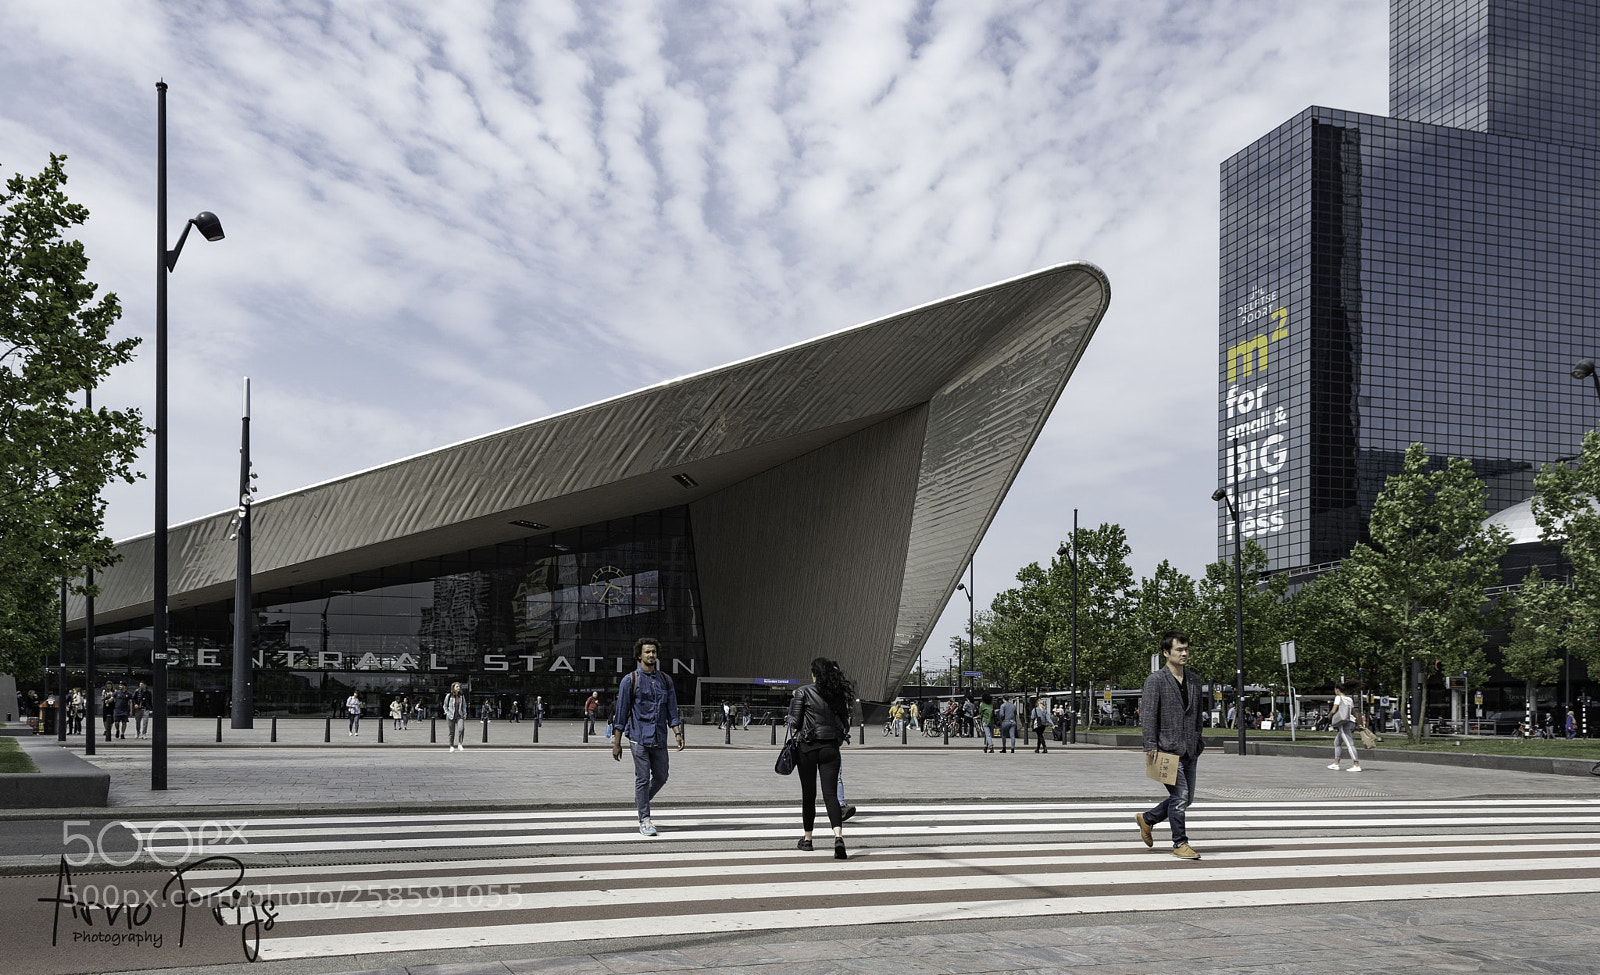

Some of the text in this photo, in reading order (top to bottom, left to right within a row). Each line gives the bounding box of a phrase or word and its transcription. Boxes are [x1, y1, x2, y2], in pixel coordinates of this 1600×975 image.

[1237, 290, 1277, 317] DELFTSE
[1241, 304, 1273, 326] POORT
[1226, 383, 1268, 419] for
[1227, 405, 1288, 441] small &
[1226, 434, 1288, 485] BIG
